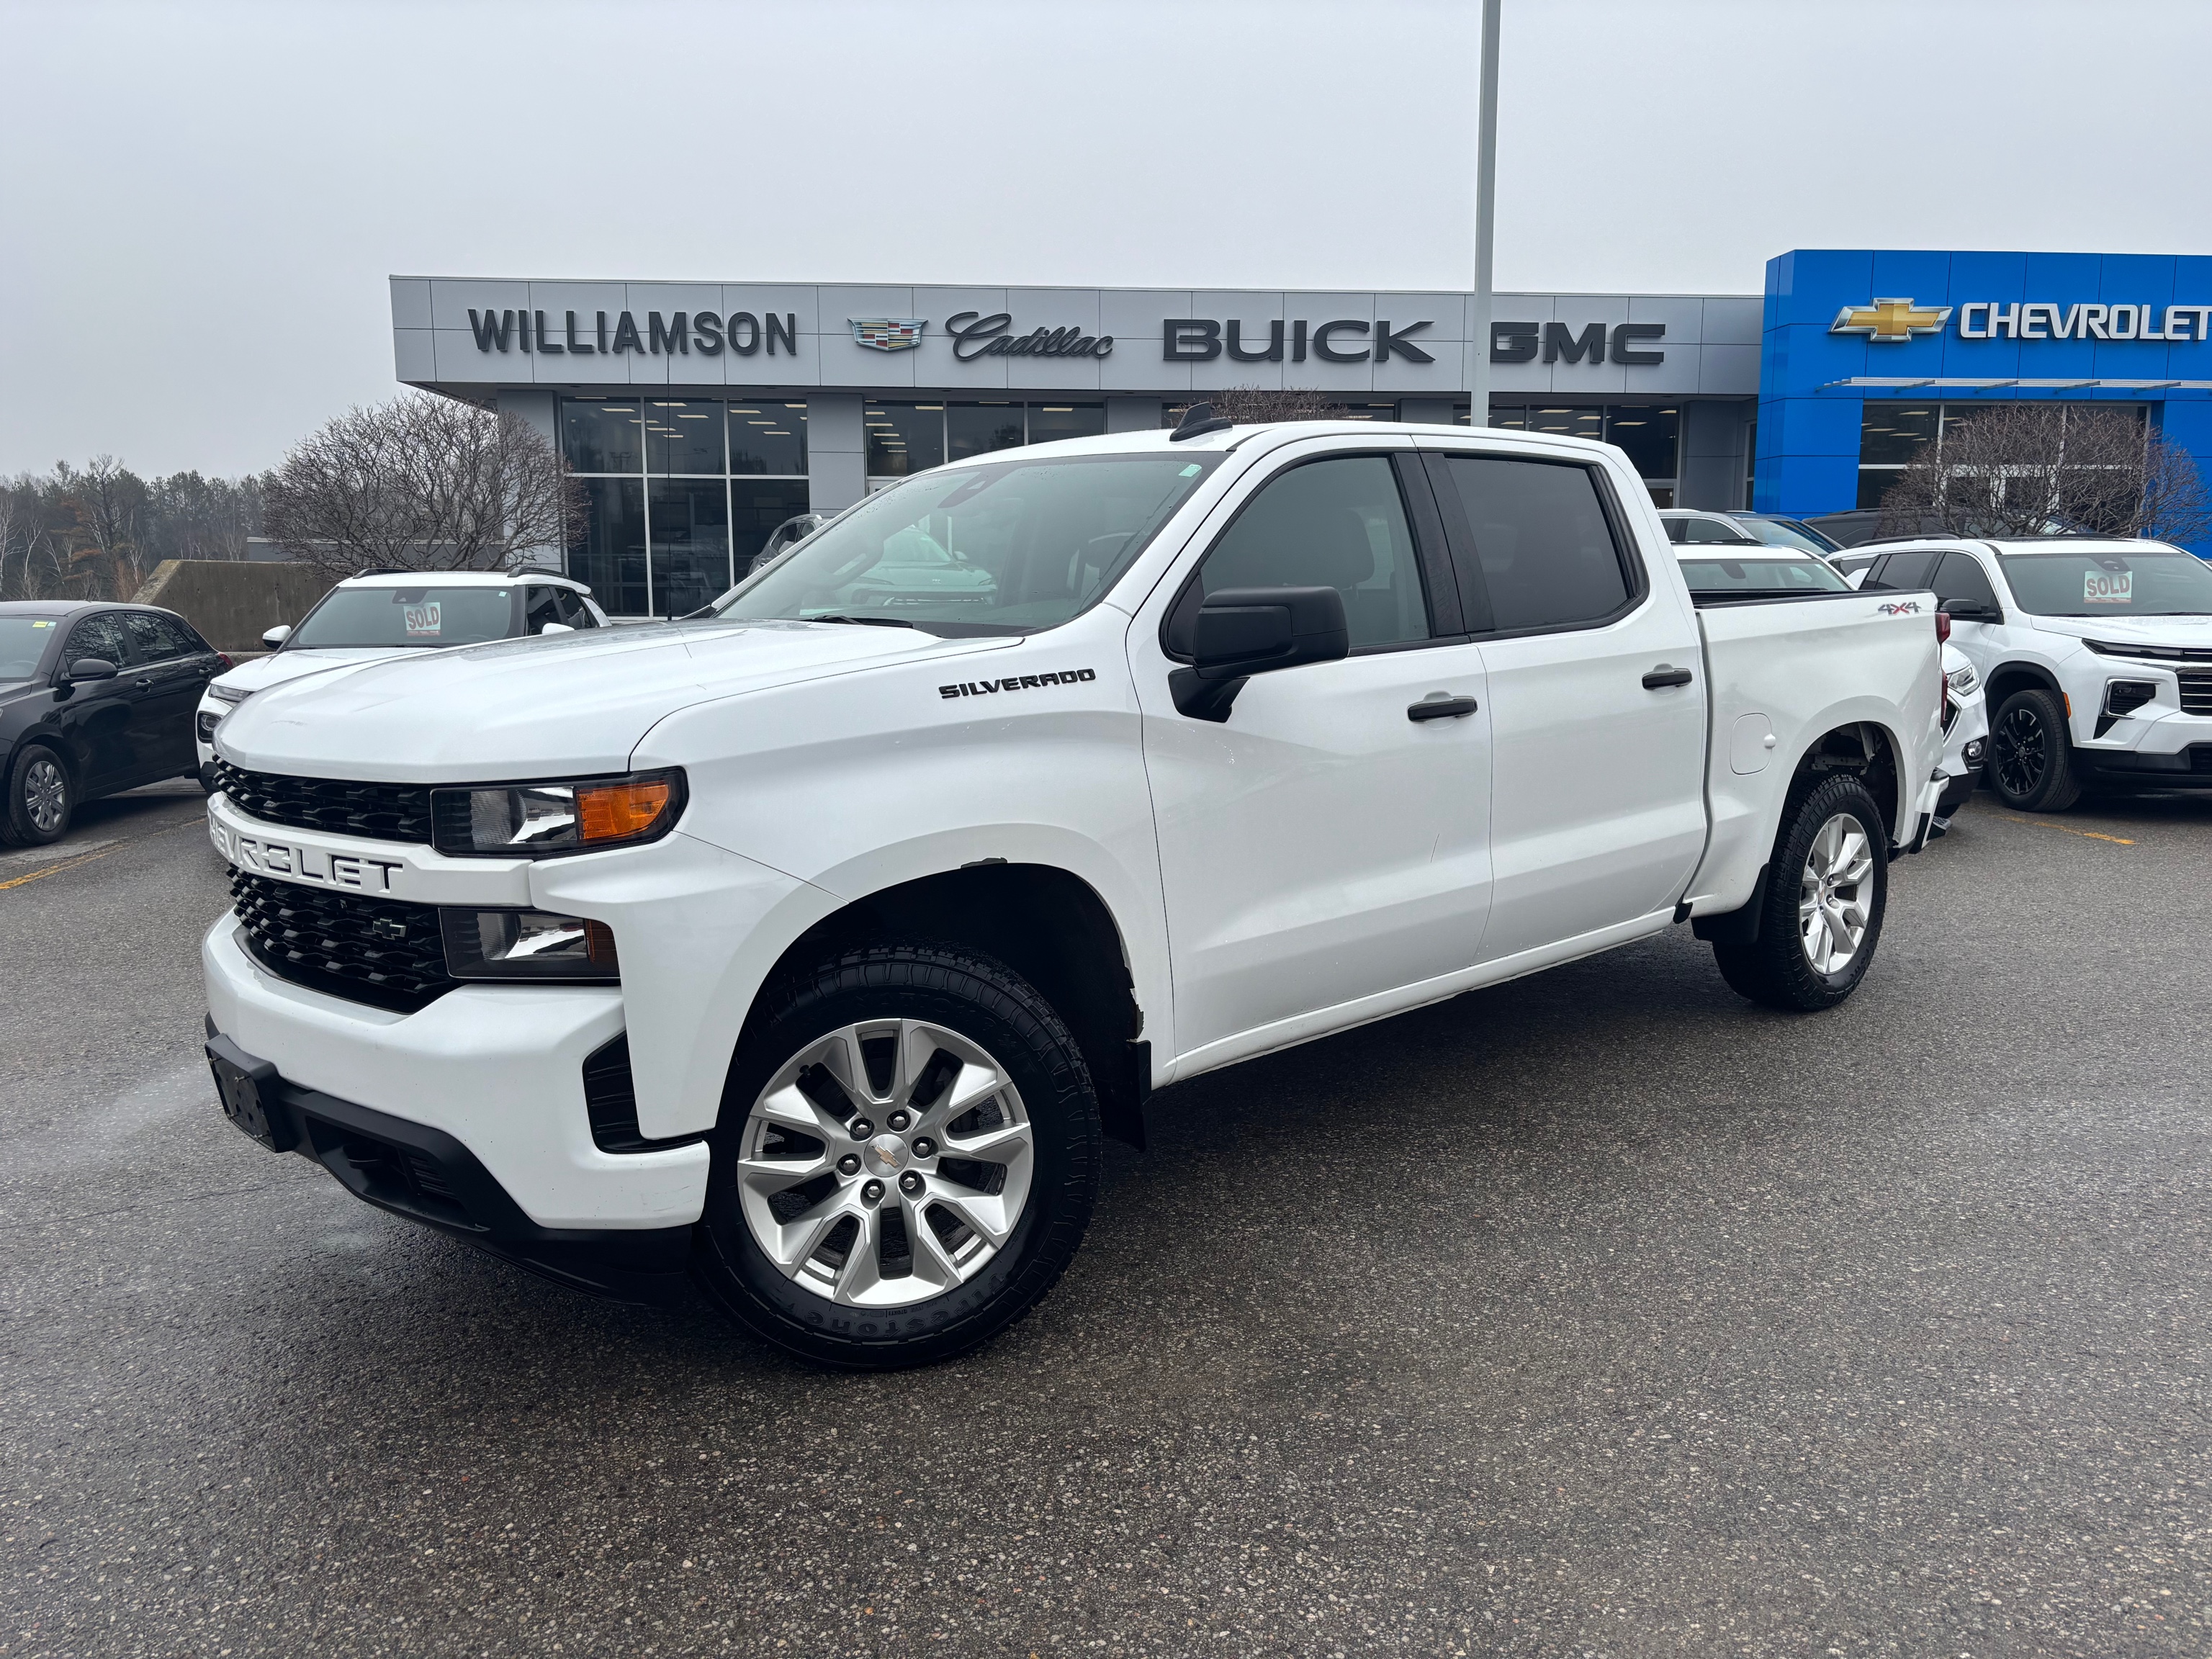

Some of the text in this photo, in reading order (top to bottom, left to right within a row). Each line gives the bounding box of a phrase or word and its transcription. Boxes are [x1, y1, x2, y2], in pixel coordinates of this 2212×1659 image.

[467, 309, 796, 355] WILLIAMSON
[945, 312, 1114, 360] Cadillac
[1164, 319, 1436, 361] BUICK
[1960, 302, 2212, 340] CHEVROLET
[1490, 322, 1665, 362] GMC
[2086, 575, 2130, 596] SOLD
[406, 606, 439, 629] SOLD
[938, 668, 1097, 699] SILVERADO
